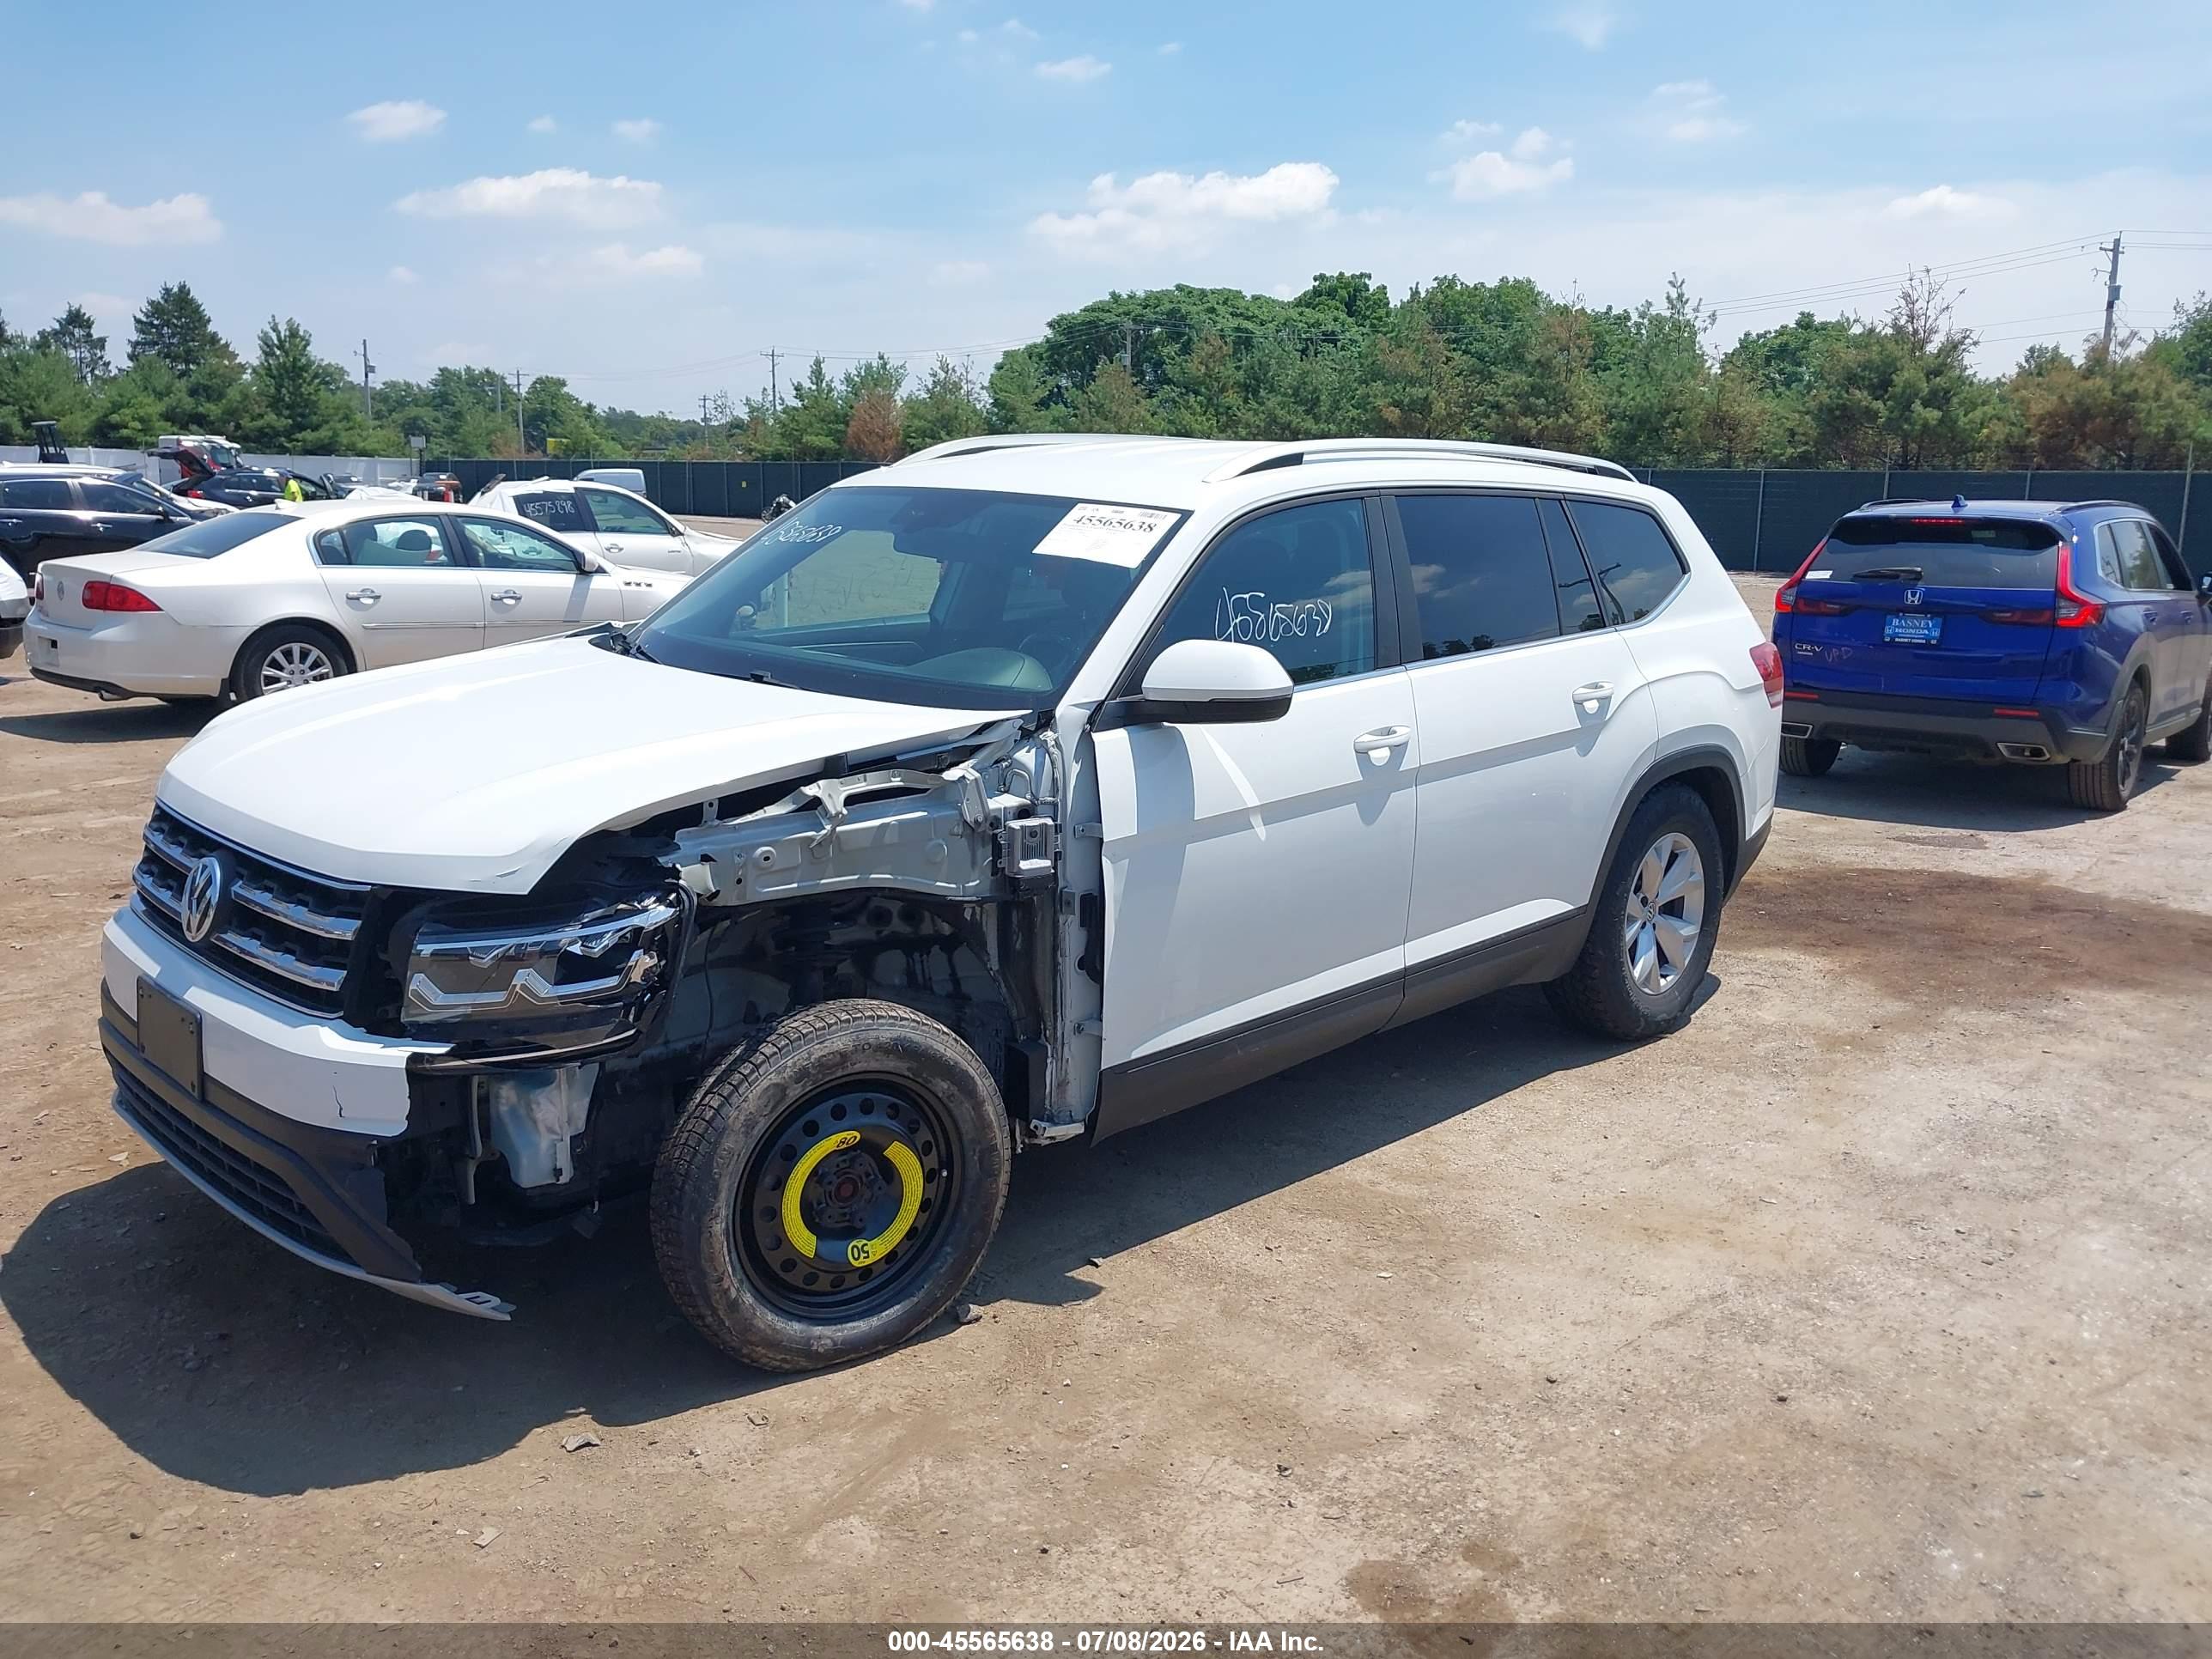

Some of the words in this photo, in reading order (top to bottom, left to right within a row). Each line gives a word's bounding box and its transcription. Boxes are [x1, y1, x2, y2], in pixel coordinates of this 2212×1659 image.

[523, 500, 575, 516] 45575898
[1073, 515, 1157, 532] 45565638
[1893, 618, 1934, 628] BASNEY
[1795, 642, 1823, 652] CR-V
[836, 1135, 857, 1149] 80
[851, 1243, 870, 1261] 50
